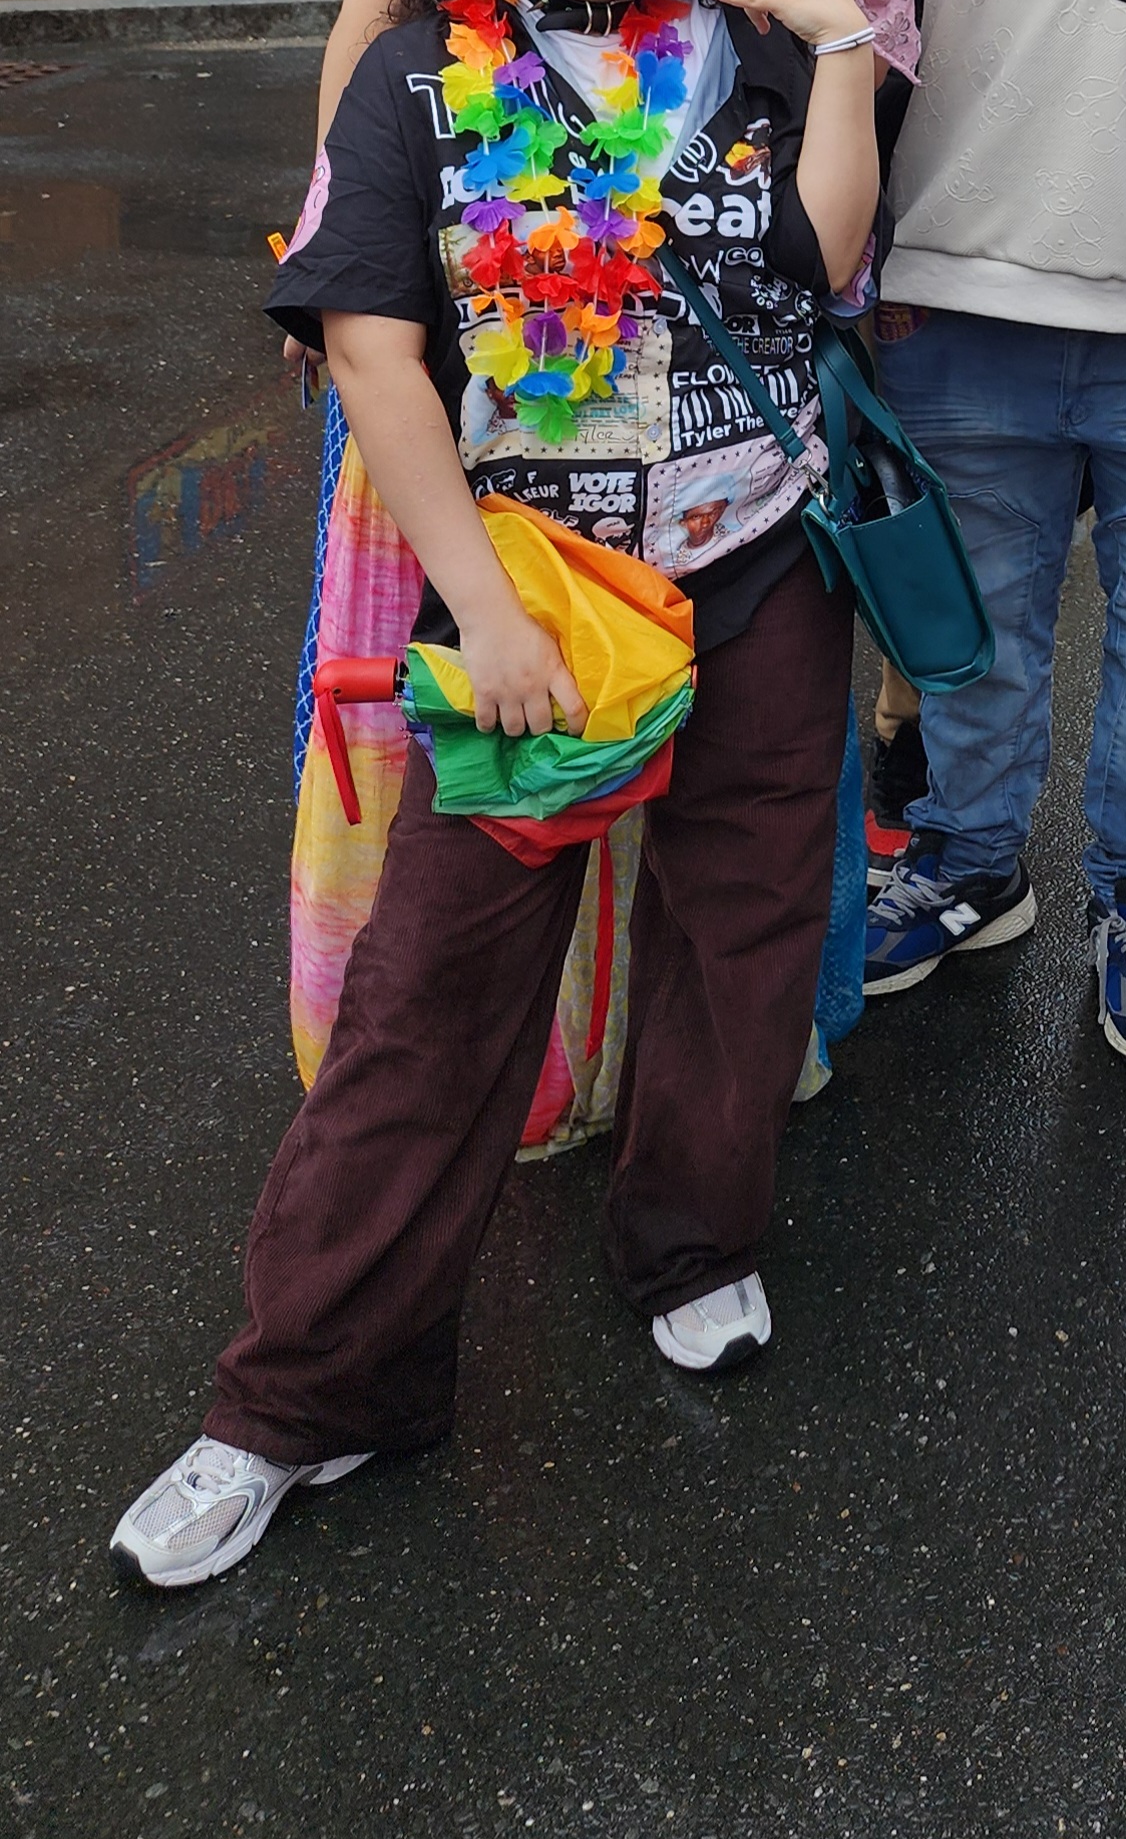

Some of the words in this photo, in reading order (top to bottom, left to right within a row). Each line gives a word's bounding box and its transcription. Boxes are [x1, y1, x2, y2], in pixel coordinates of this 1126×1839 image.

[752, 335, 794, 355] CREATOR
[681, 423, 732, 447] Tyler
[735, 414, 765, 433] The
[569, 472, 637, 494] VOTE
[568, 493, 637, 514] IGOR
